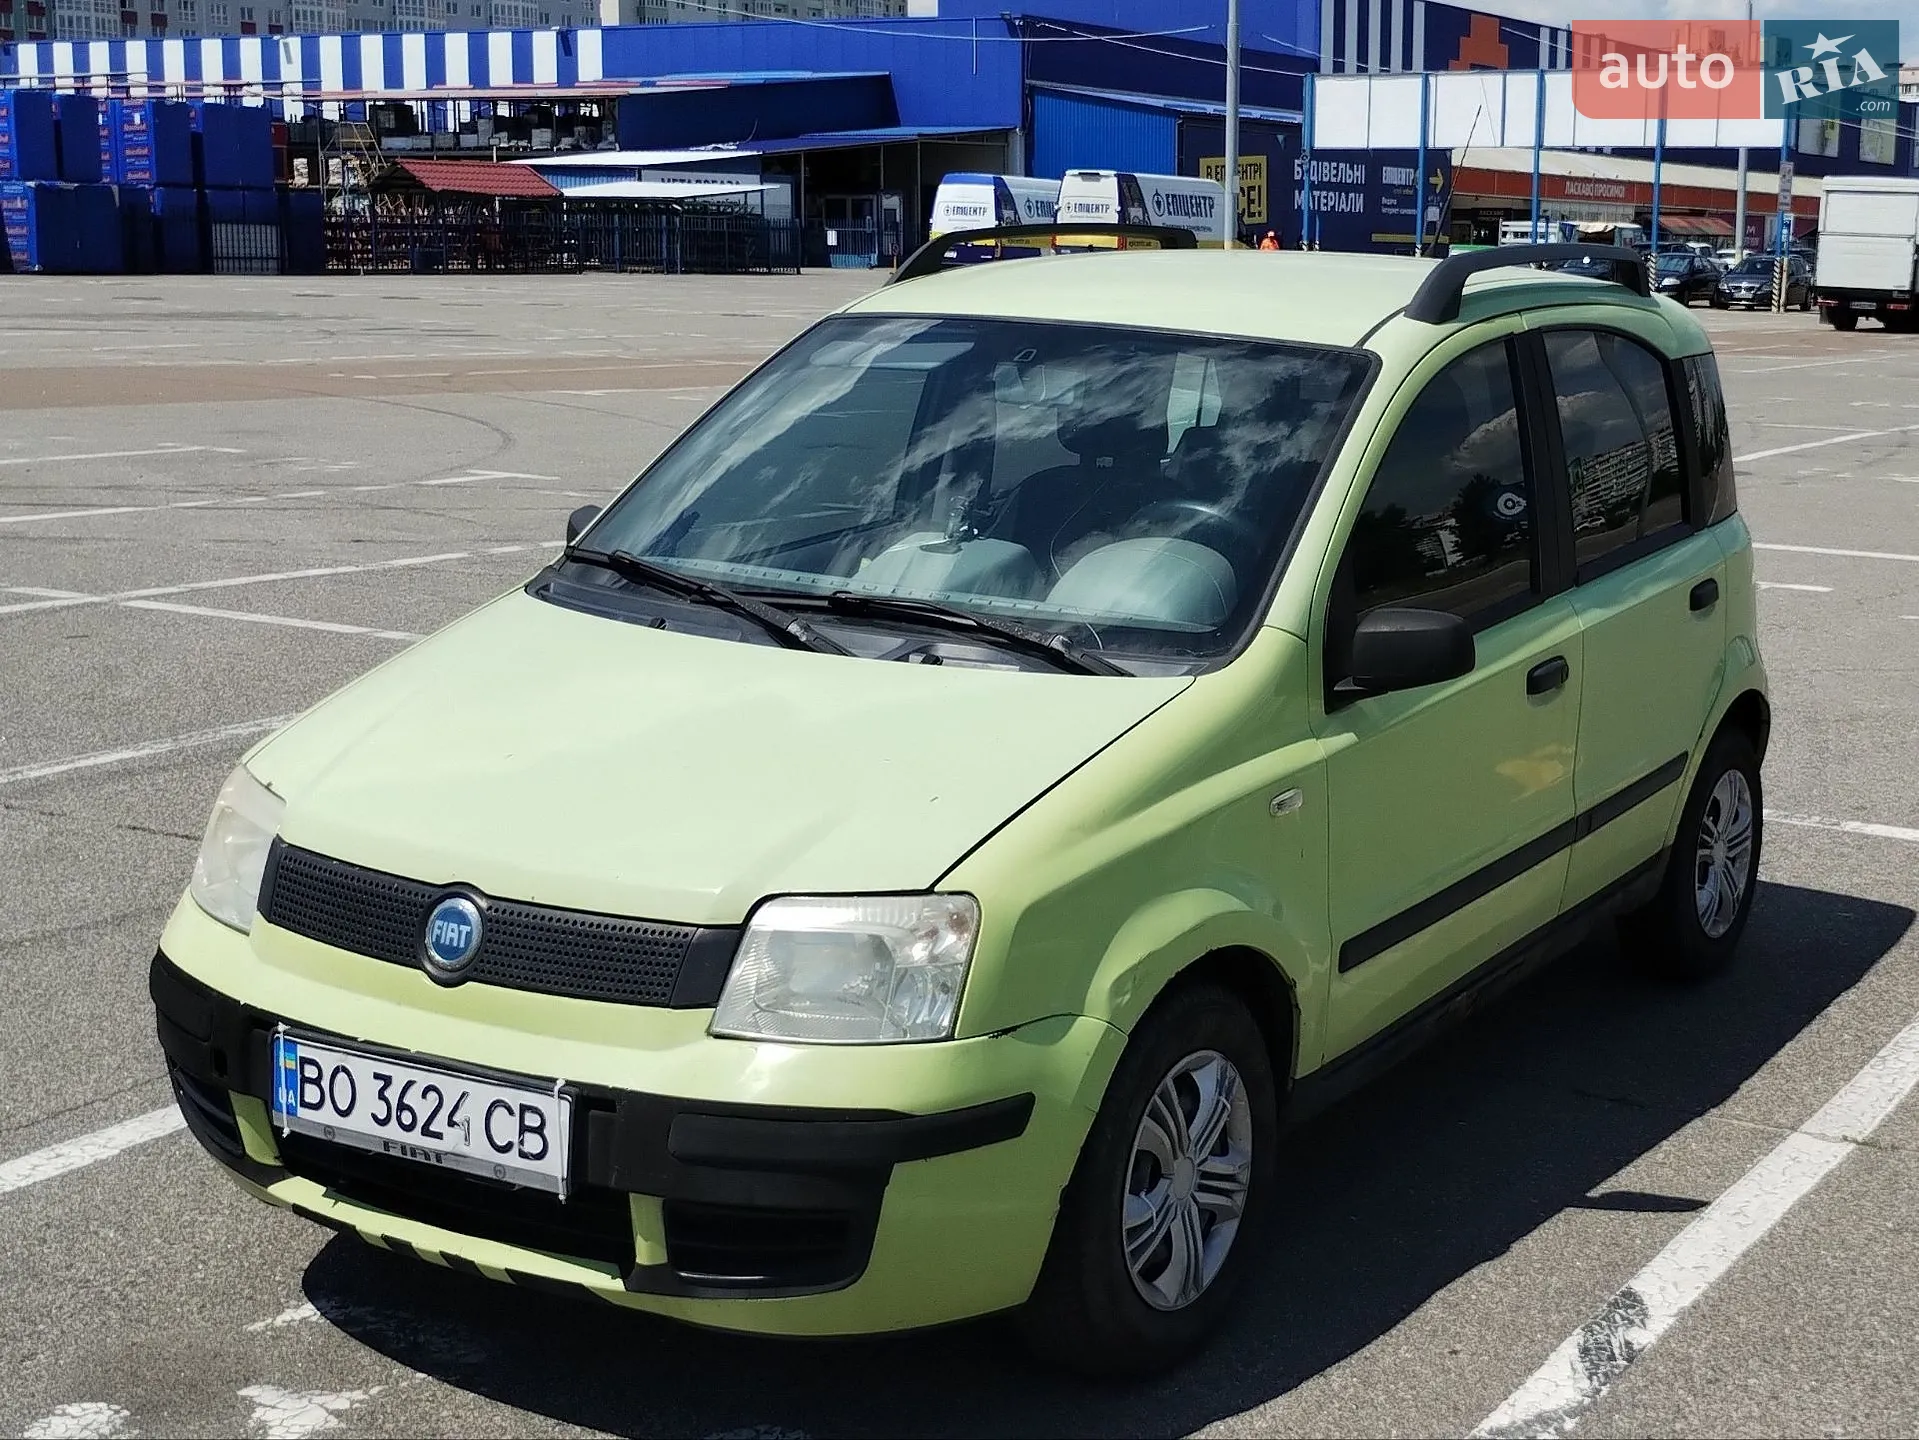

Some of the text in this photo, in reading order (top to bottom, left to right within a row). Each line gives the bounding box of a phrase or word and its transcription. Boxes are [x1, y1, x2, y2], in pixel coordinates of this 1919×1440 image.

[1564, 180, 1594, 196] ЛАСКАВО
[1073, 203, 1110, 214] ЕПІЦЕНТР
[1165, 193, 1216, 219] ЕПІЦЕНТР
[432, 919, 471, 948] FIAT
[299, 1056, 550, 1161] BO 3624 CB
